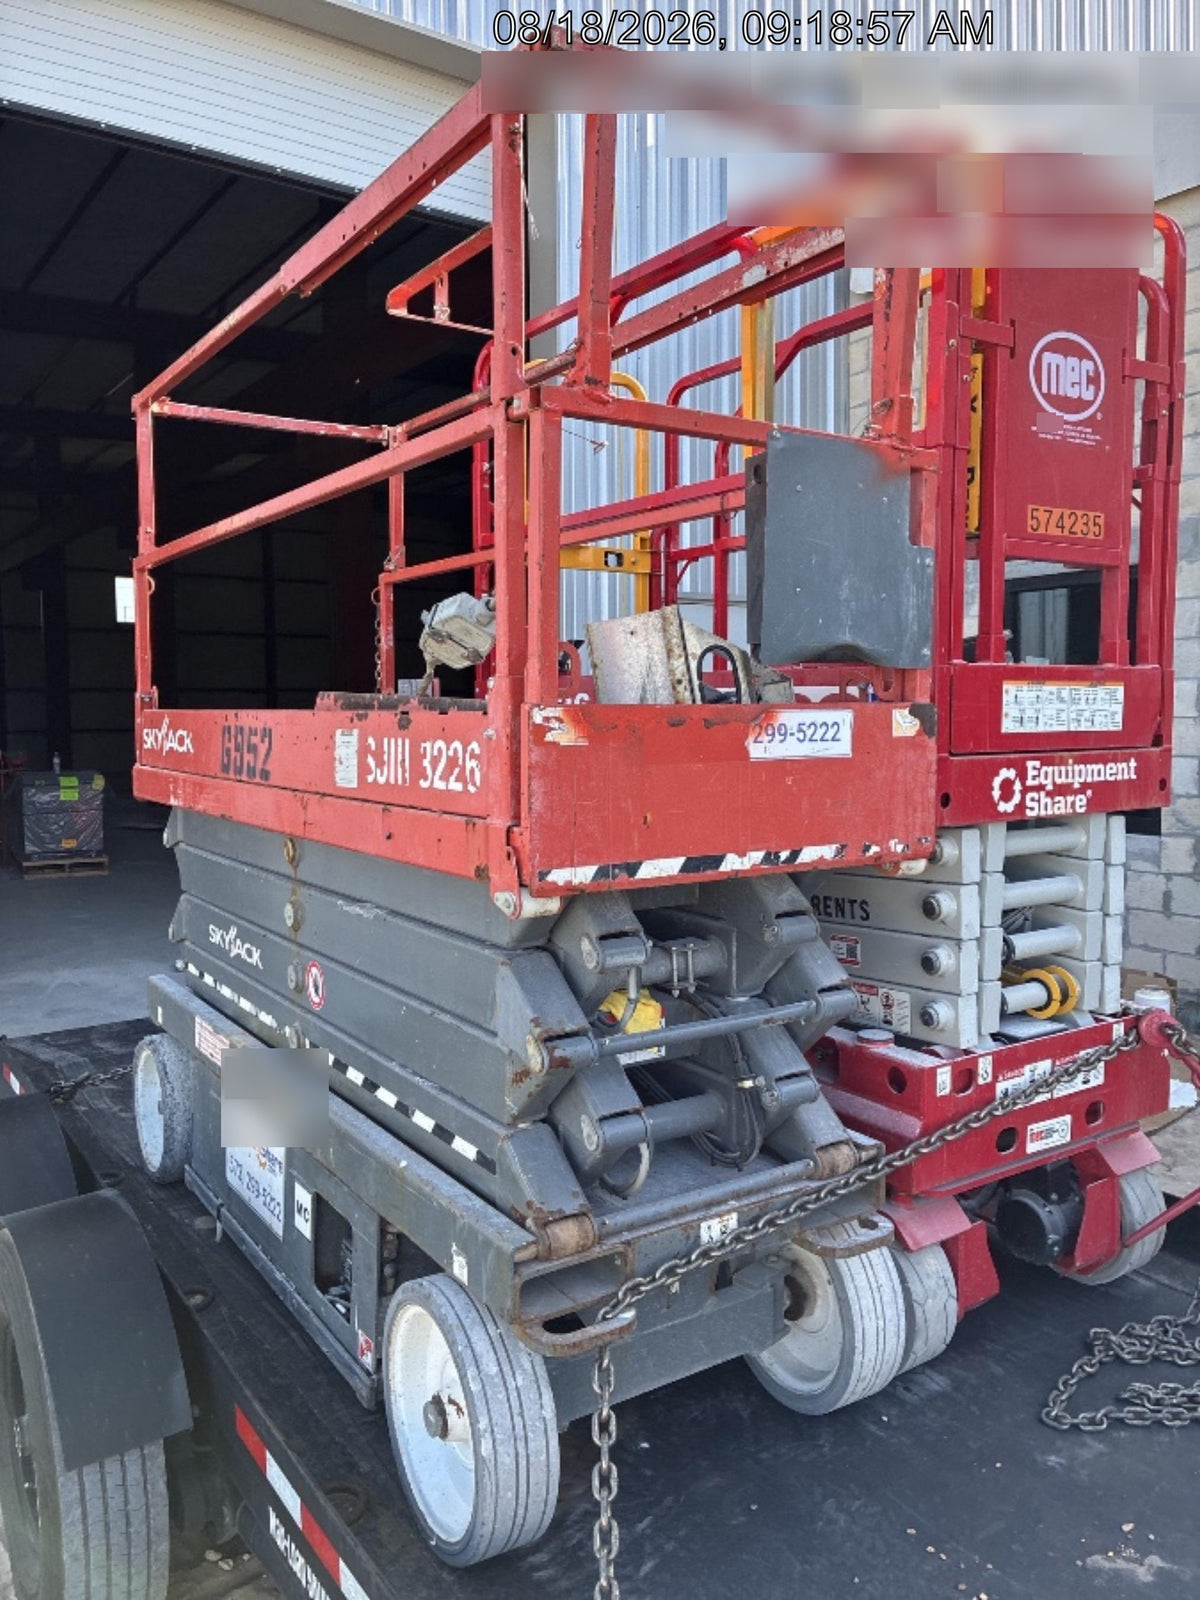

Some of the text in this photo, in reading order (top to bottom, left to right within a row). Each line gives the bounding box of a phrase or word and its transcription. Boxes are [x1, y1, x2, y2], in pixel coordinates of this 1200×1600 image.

[1030, 507, 1102, 538] 574235
[142, 714, 194, 756] SKYJACK
[752, 720, 842, 744] 299-5222
[418, 738, 481, 794] 3226
[1025, 757, 1137, 791] Equipment
[810, 894, 871, 921] RENTS
[208, 924, 264, 970] SKYJACK
